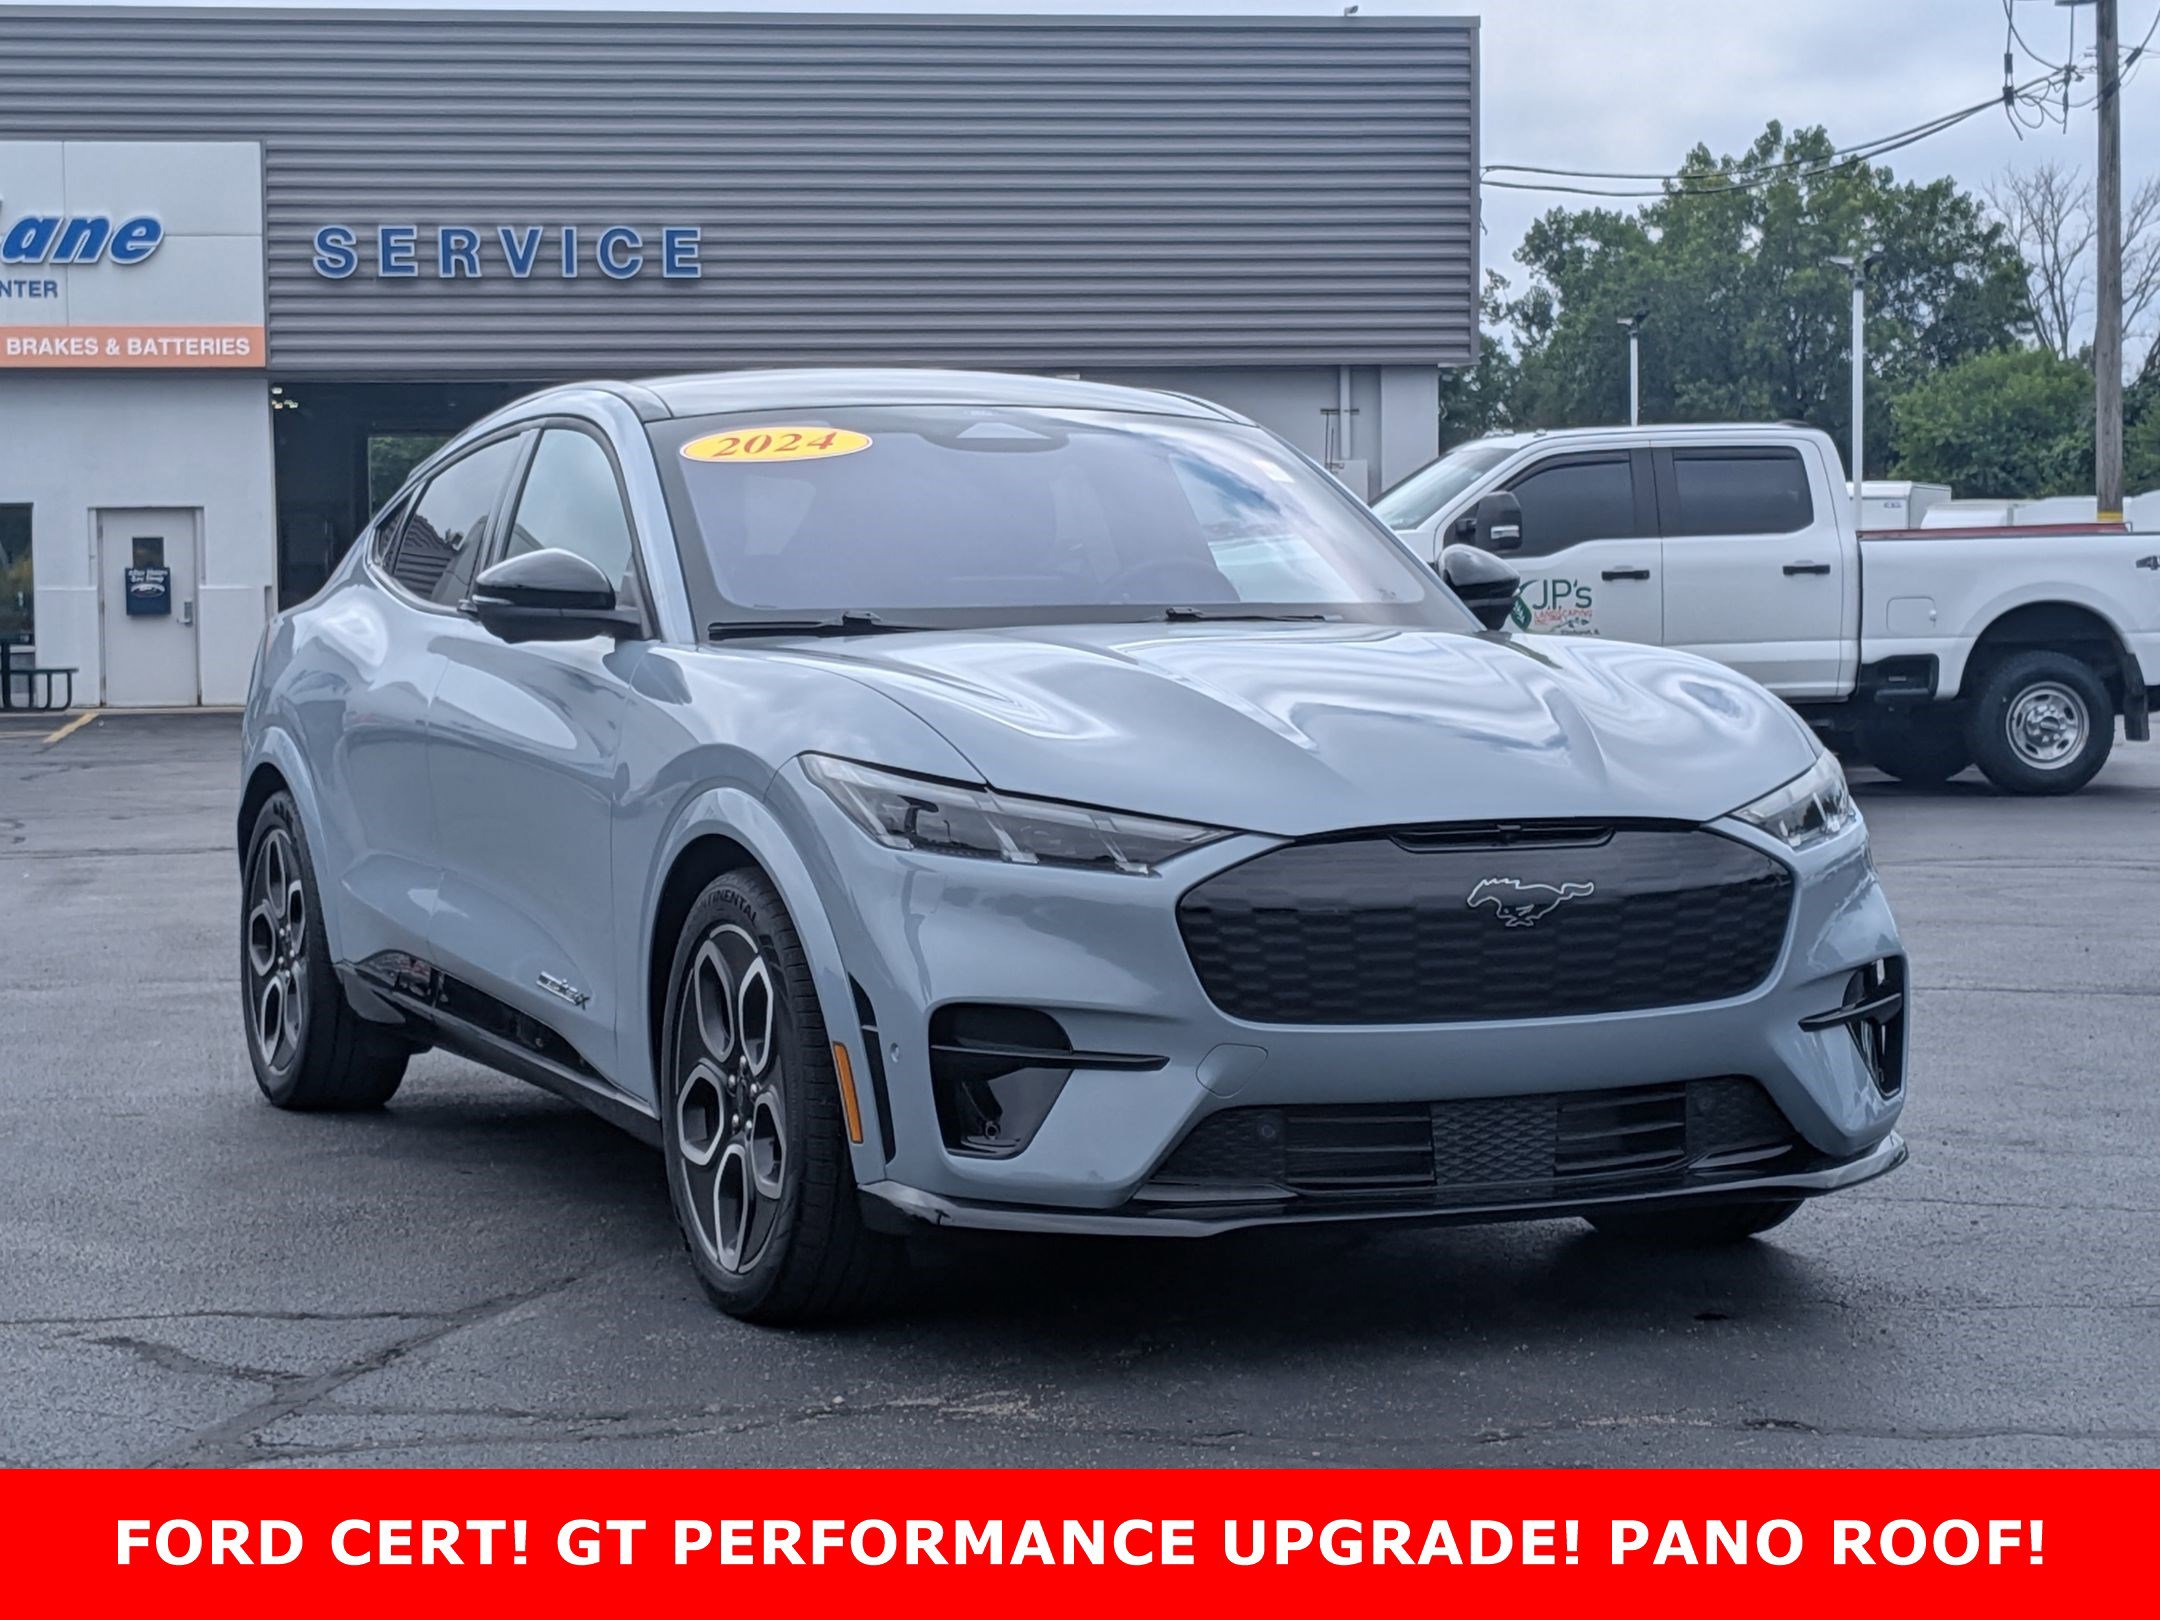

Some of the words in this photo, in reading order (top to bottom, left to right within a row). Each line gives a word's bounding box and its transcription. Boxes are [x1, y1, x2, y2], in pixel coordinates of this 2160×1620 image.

[0, 213, 163, 262] ane
[313, 225, 701, 279] SERVICE
[6, 337, 98, 356] BRAKES
[105, 337, 120, 356] &
[127, 337, 250, 356] BATTERIES
[712, 431, 838, 458] 2024
